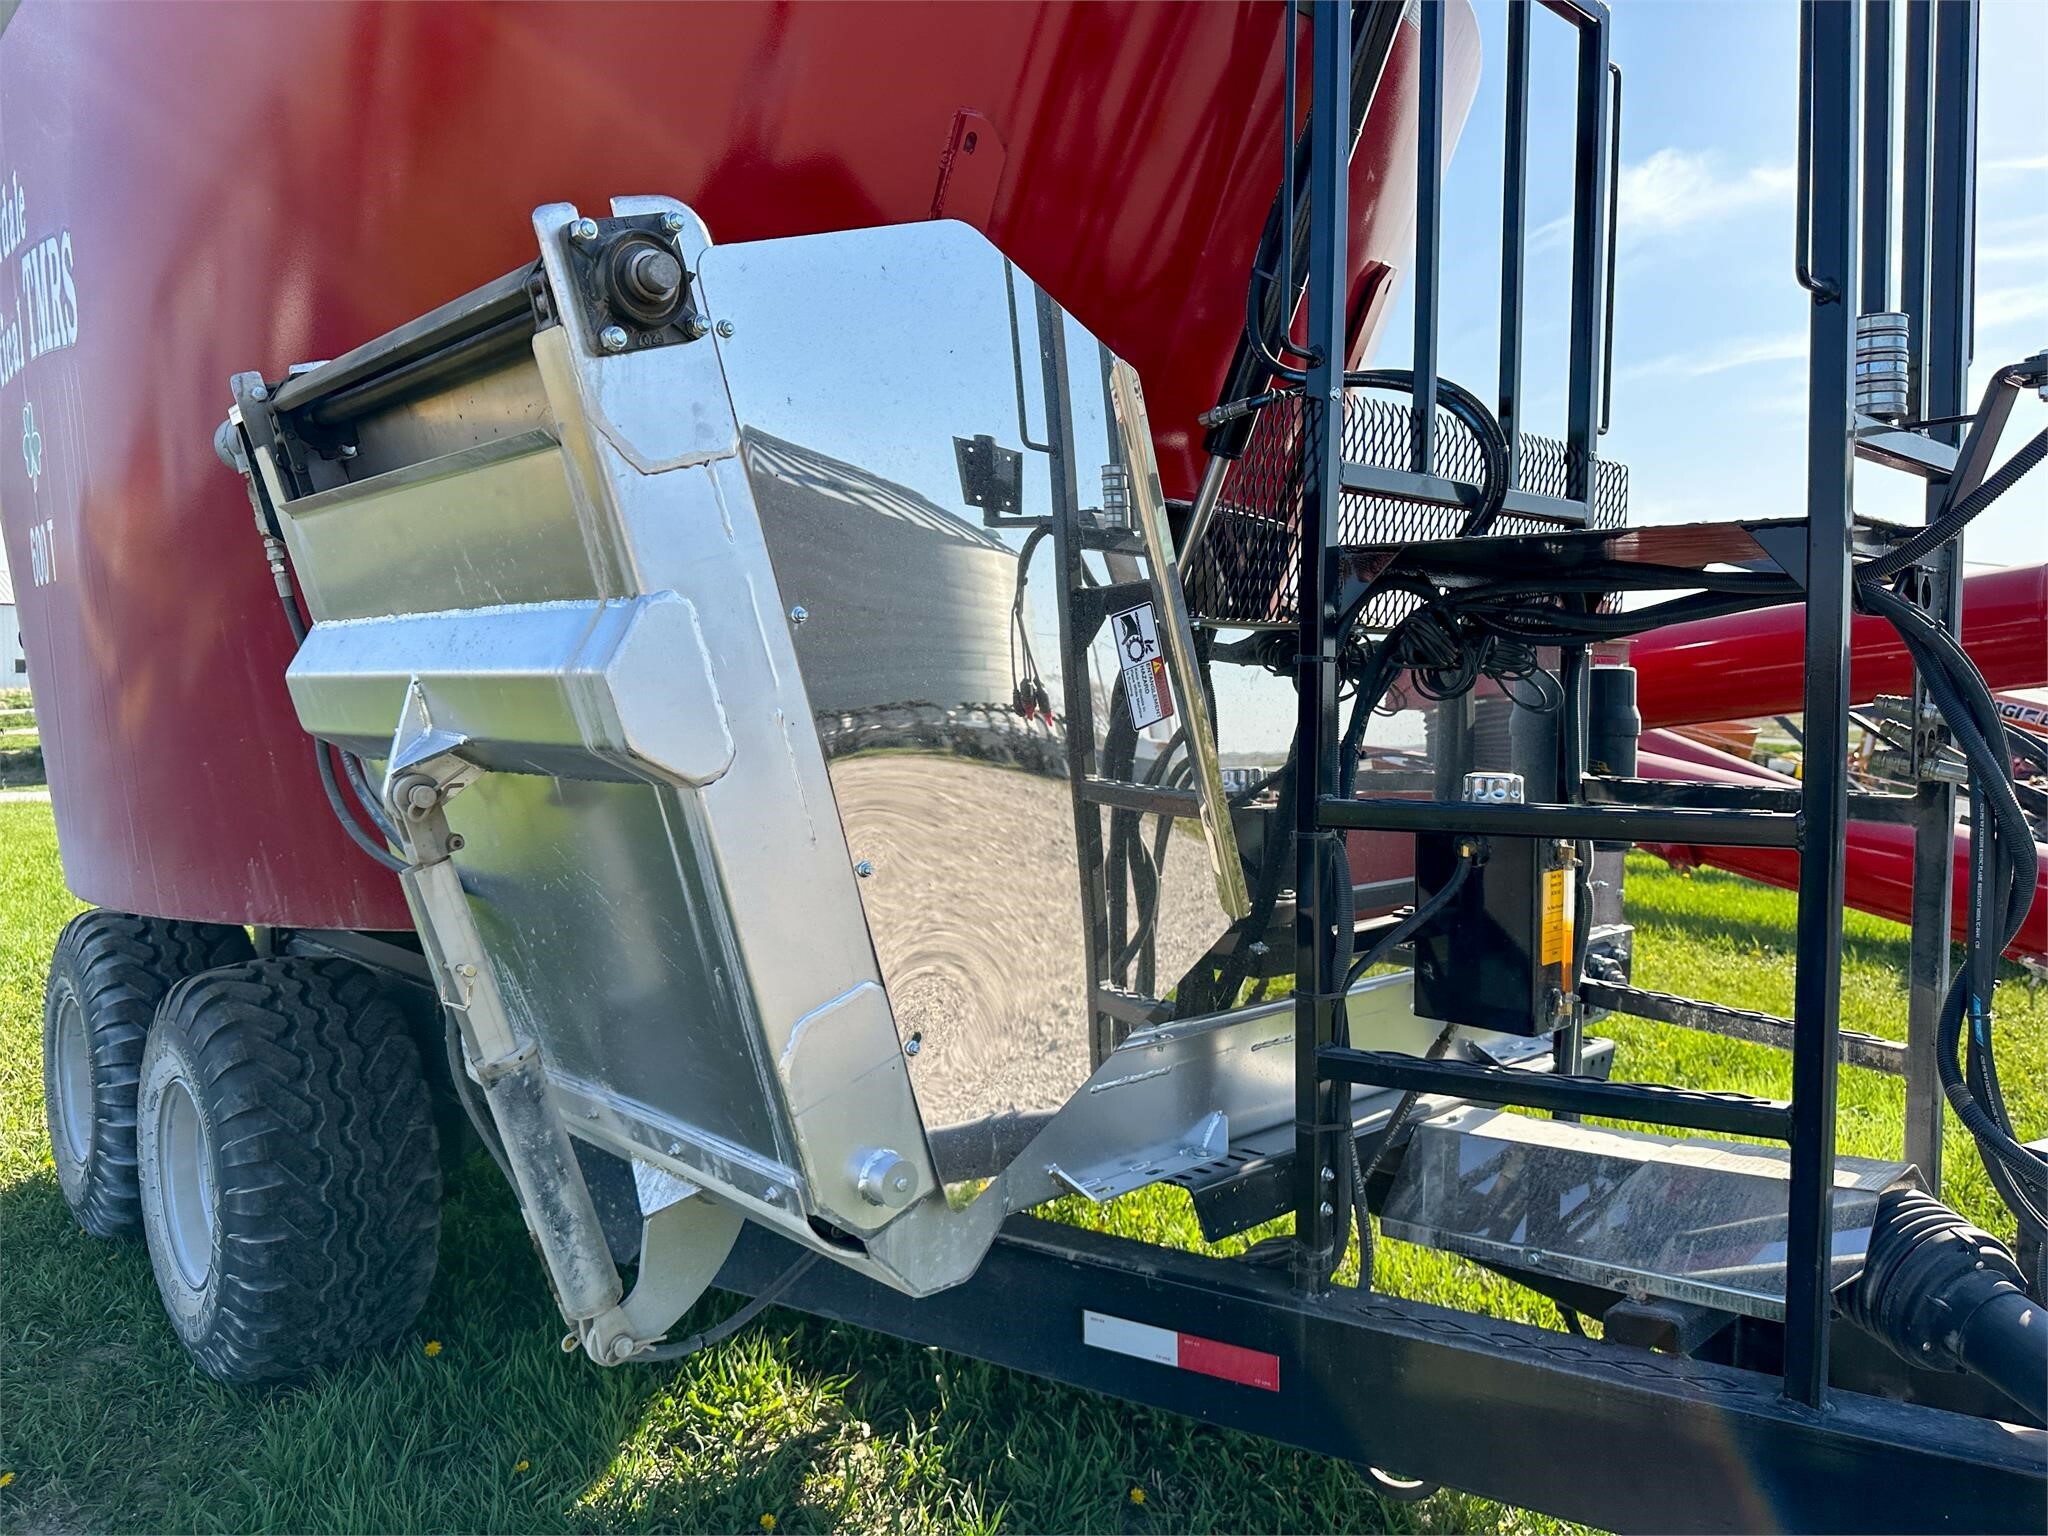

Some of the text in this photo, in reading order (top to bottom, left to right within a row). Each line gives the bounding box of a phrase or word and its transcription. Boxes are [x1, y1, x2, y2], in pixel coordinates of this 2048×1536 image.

[0, 170, 26, 264] dale
[21, 229, 78, 360] TMRS
[1140, 665, 1150, 694] HAZARD
[1145, 662, 1161, 718] ENTANGLEMENT
